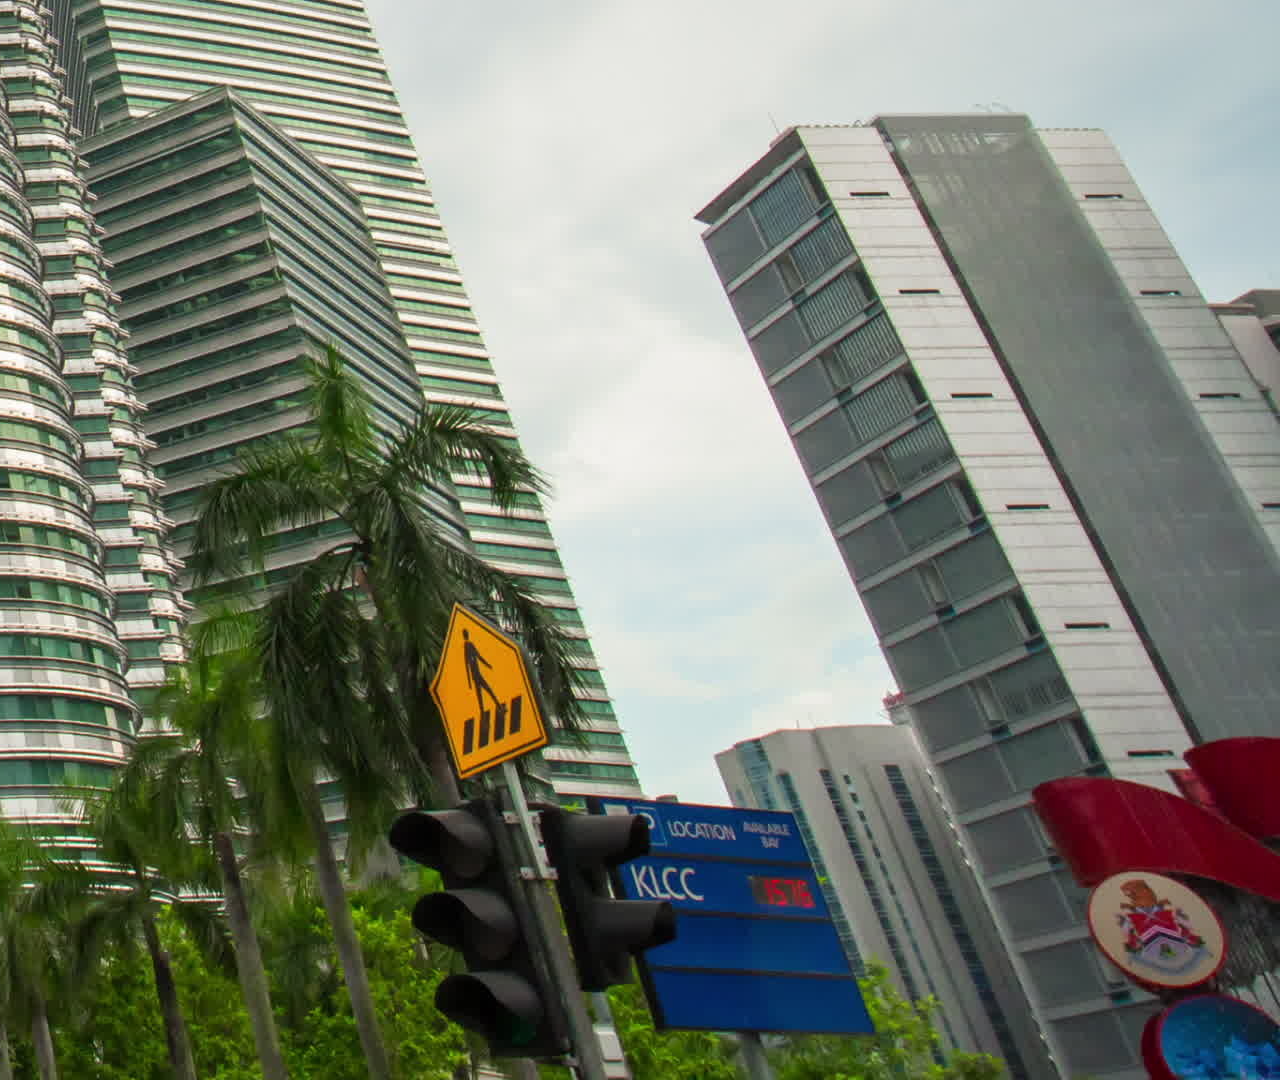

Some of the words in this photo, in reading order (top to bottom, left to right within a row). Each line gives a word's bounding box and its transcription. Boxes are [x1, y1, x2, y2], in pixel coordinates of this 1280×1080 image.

[667, 820, 737, 840] LOCATION
[743, 822, 792, 836] AVAILABLE
[630, 864, 705, 901] KLCC
